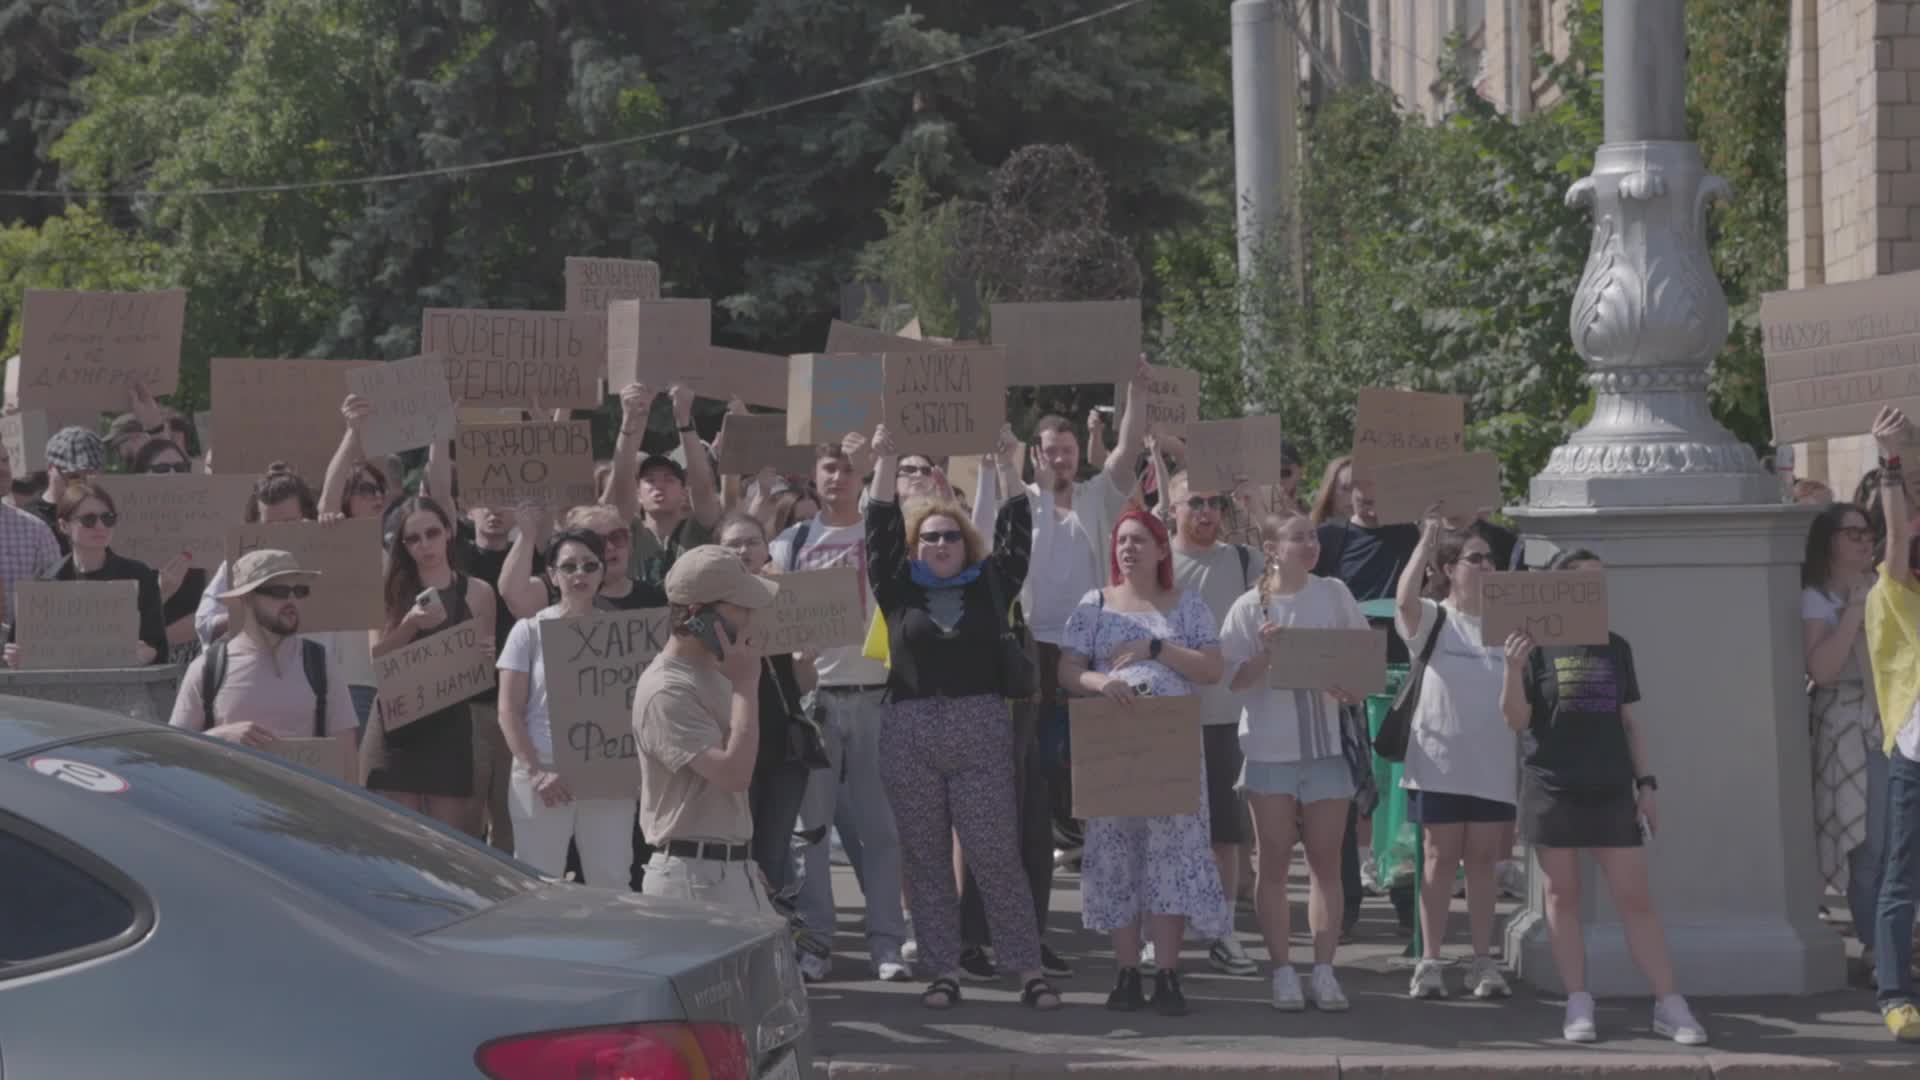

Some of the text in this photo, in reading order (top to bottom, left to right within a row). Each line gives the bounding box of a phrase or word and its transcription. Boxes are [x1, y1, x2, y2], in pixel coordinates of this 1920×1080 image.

[430, 313, 583, 360] ПОВЕРНІТЬ
[896, 354, 972, 395] ДУРКА
[900, 401, 975, 435] ЄБАТЬ
[460, 423, 589, 457] ФЕДОРОВ
[481, 459, 549, 486] МО
[1482, 582, 1602, 606] ФЕДОРОВ
[1526, 613, 1563, 638] МО
[381, 657, 402, 681] ЗА
[440, 628, 476, 658] ХТО
